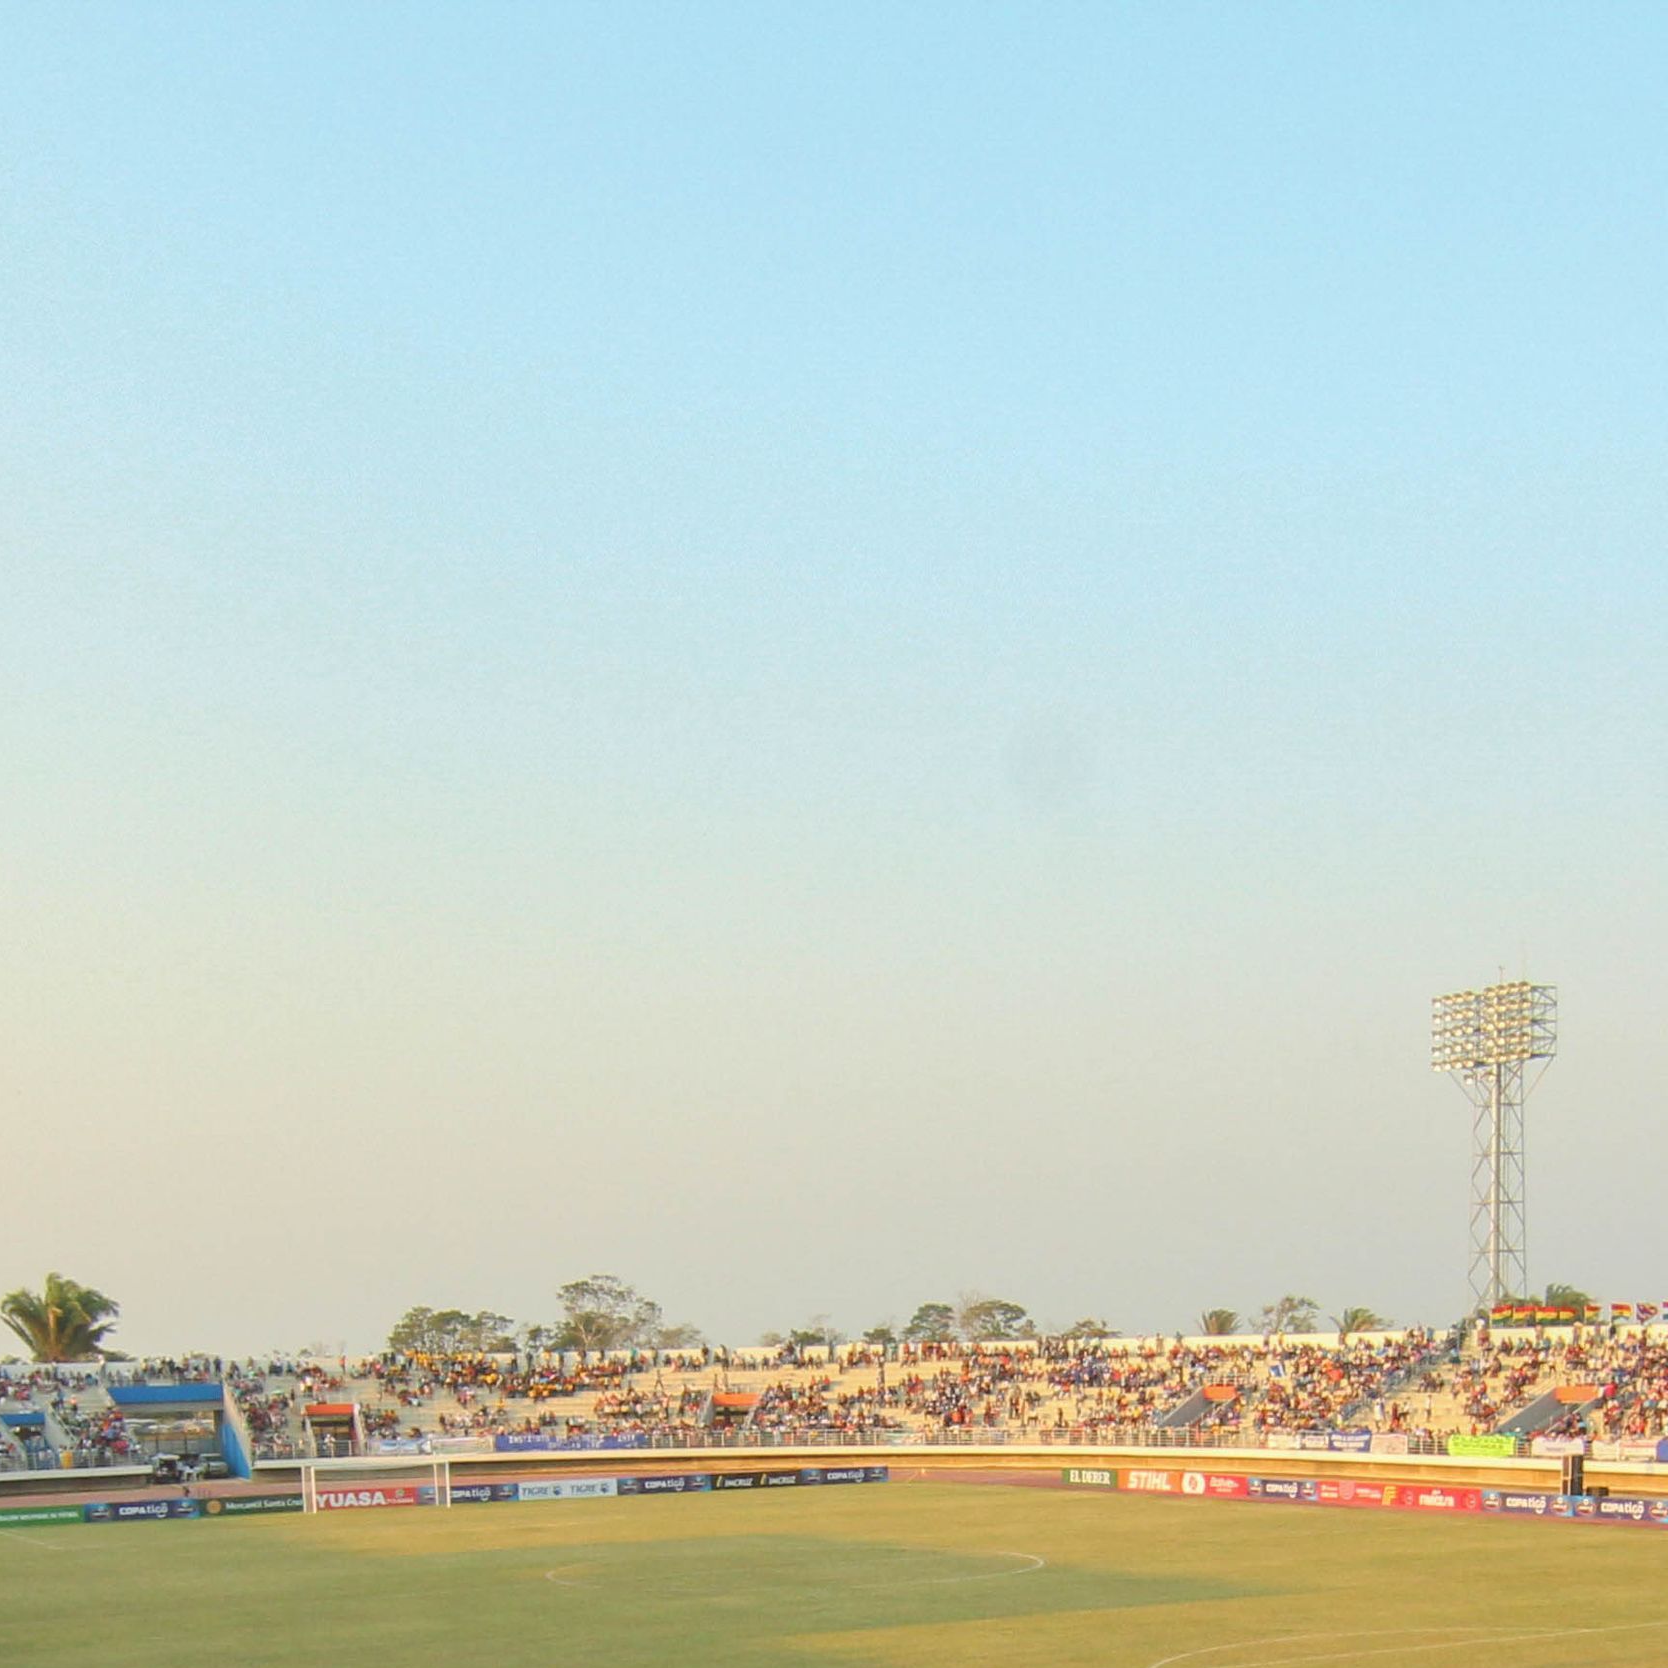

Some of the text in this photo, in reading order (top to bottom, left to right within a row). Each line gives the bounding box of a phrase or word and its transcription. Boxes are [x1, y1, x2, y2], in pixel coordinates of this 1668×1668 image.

[1069, 1470, 1111, 1485] EL DEBER
[1127, 1471, 1172, 1491] STIHL
[522, 1486, 549, 1497] TIGRE
[570, 1484, 596, 1495] TIGRE
[315, 1491, 386, 1508] YUASA
